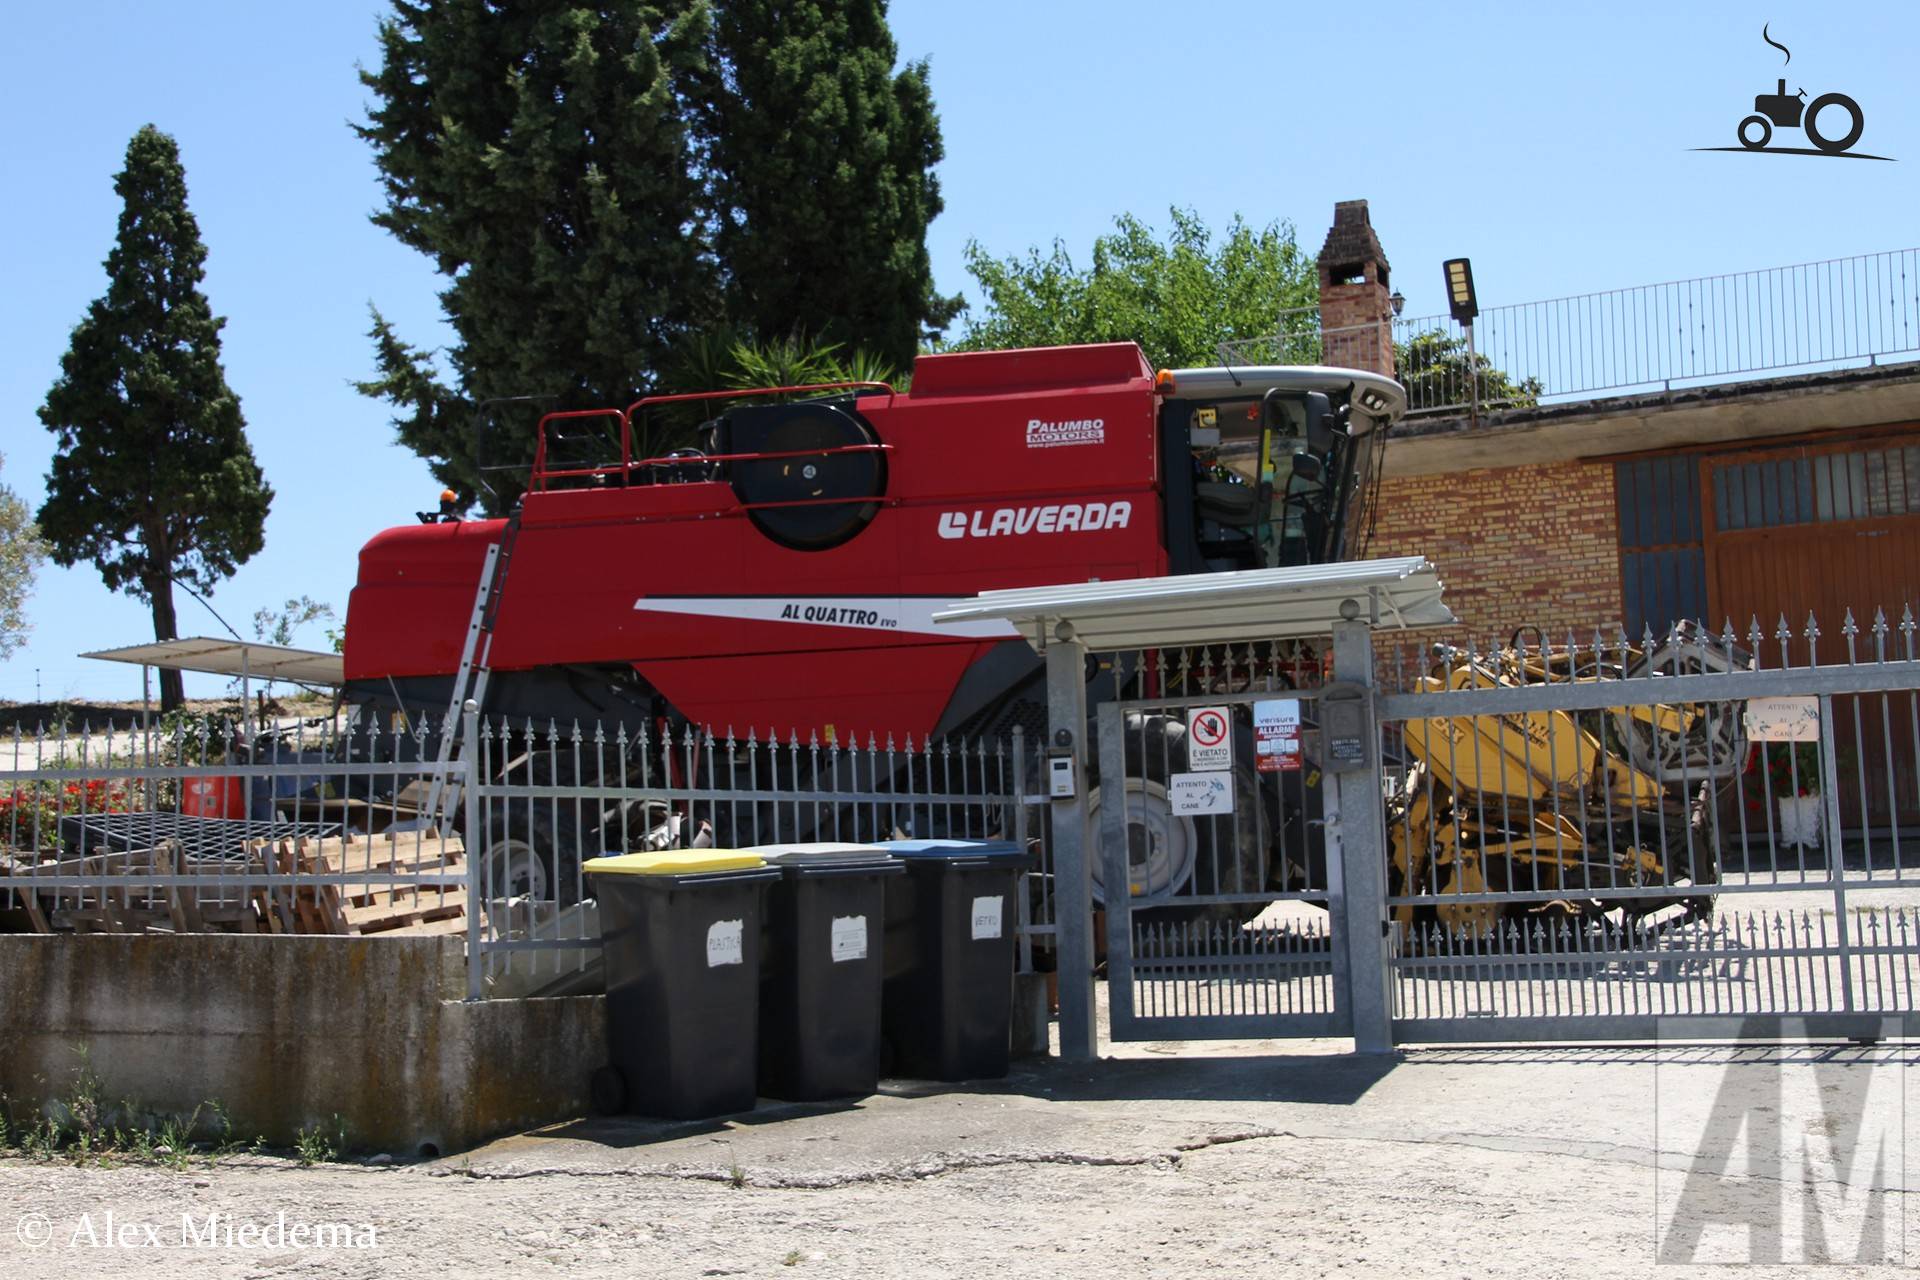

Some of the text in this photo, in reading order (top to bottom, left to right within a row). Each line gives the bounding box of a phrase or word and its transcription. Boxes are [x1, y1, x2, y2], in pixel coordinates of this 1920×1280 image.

[1026, 418, 1104, 433] PALUMBO
[1030, 431, 1101, 442] MOTORS
[970, 501, 1131, 537] LAVERDA
[781, 604, 897, 628] AL QUATTRO EVO
[1258, 725, 1297, 735] ALLARME
[1199, 749, 1228, 757] VIETATO
